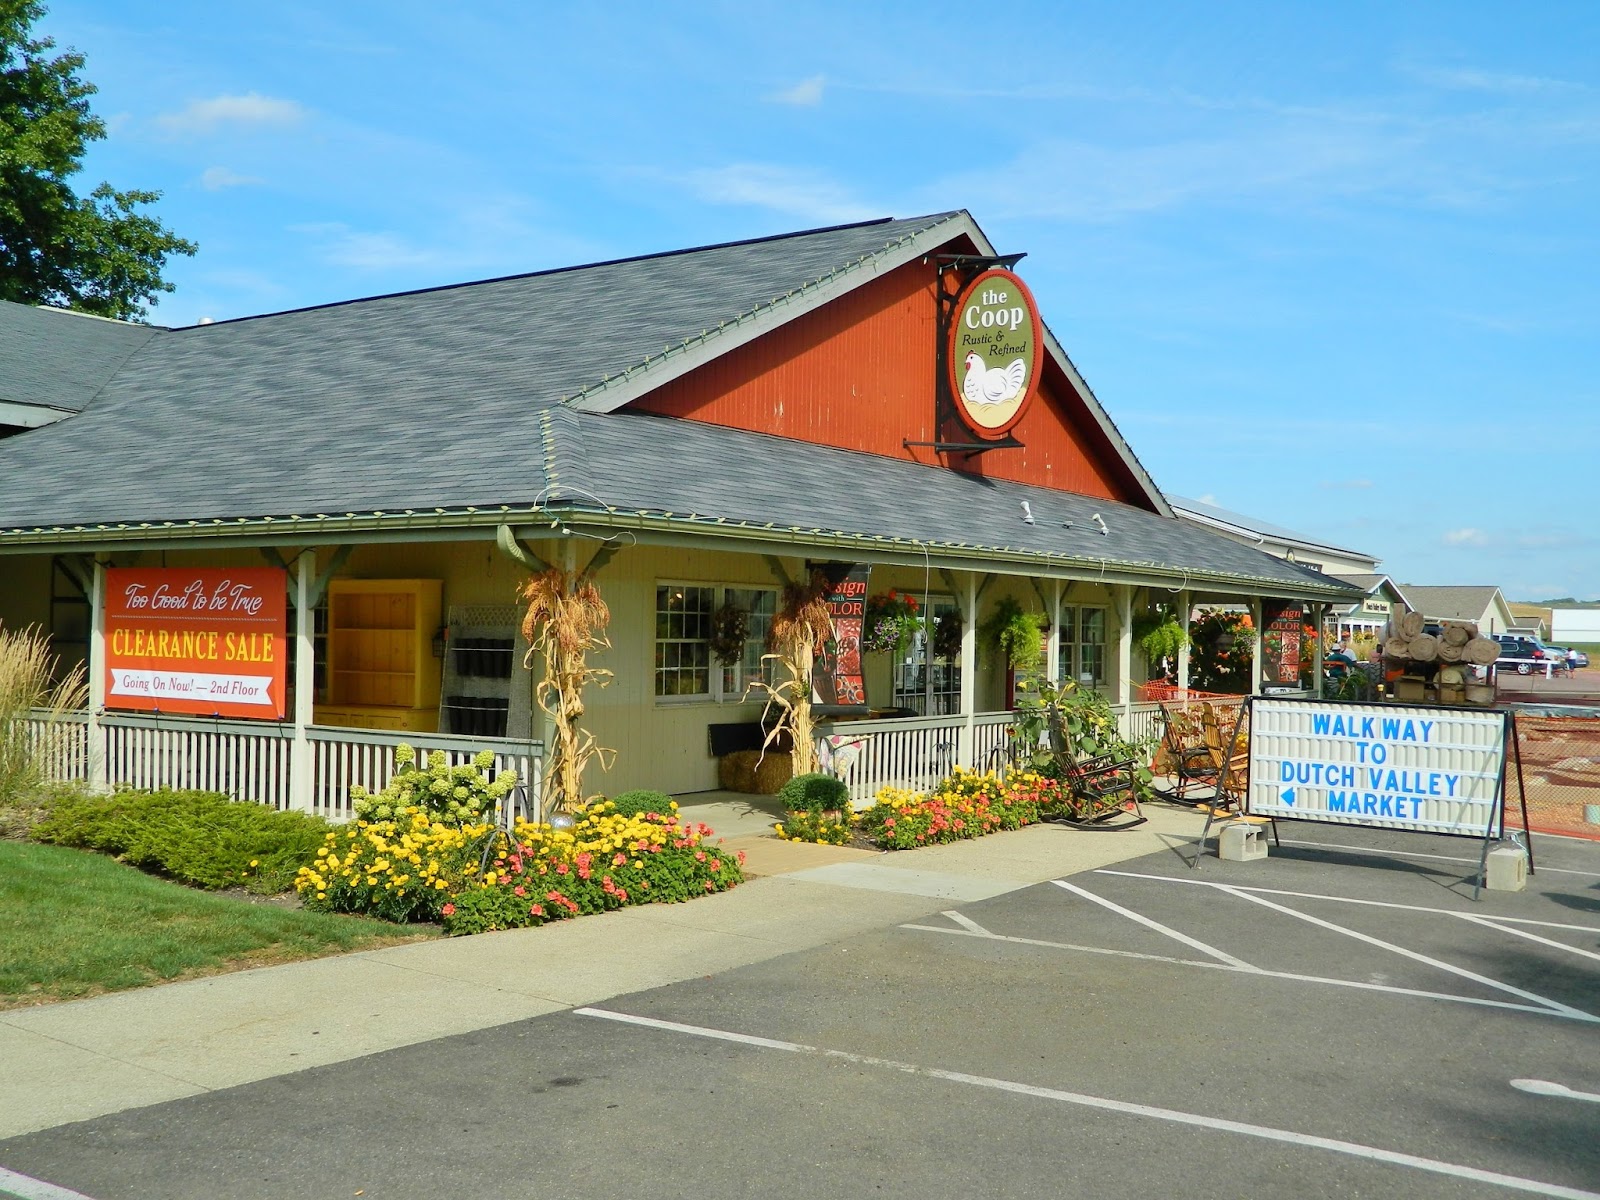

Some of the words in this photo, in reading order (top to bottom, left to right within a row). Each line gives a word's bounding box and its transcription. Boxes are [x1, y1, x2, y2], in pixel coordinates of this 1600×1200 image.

[982, 289, 1008, 305] the
[965, 305, 1024, 331] Coop
[962, 333, 992, 346] Rustic
[995, 330, 1005, 342] &
[989, 341, 1027, 356] Refined
[125, 583, 149, 608] Too
[152, 579, 202, 609] Good
[192, 588, 207, 609] to
[209, 579, 231, 610] be
[230, 583, 263, 615] True
[834, 577, 866, 597] sign
[1270, 621, 1300, 630] OLOR
[112, 628, 218, 660] CLEARANCE
[225, 631, 274, 662] SALE
[123, 674, 150, 692] Going
[153, 676, 166, 690] On
[168, 677, 194, 692] Now!
[210, 680, 229, 694] 2nd
[231, 681, 259, 696] Floor
[1313, 714, 1374, 738] WALK
[1382, 718, 1433, 742] WAY
[1356, 742, 1387, 764] TO
[1281, 761, 1354, 787] DUTCH
[1369, 768, 1459, 797] VALLEY
[1329, 790, 1422, 819] MARKET
